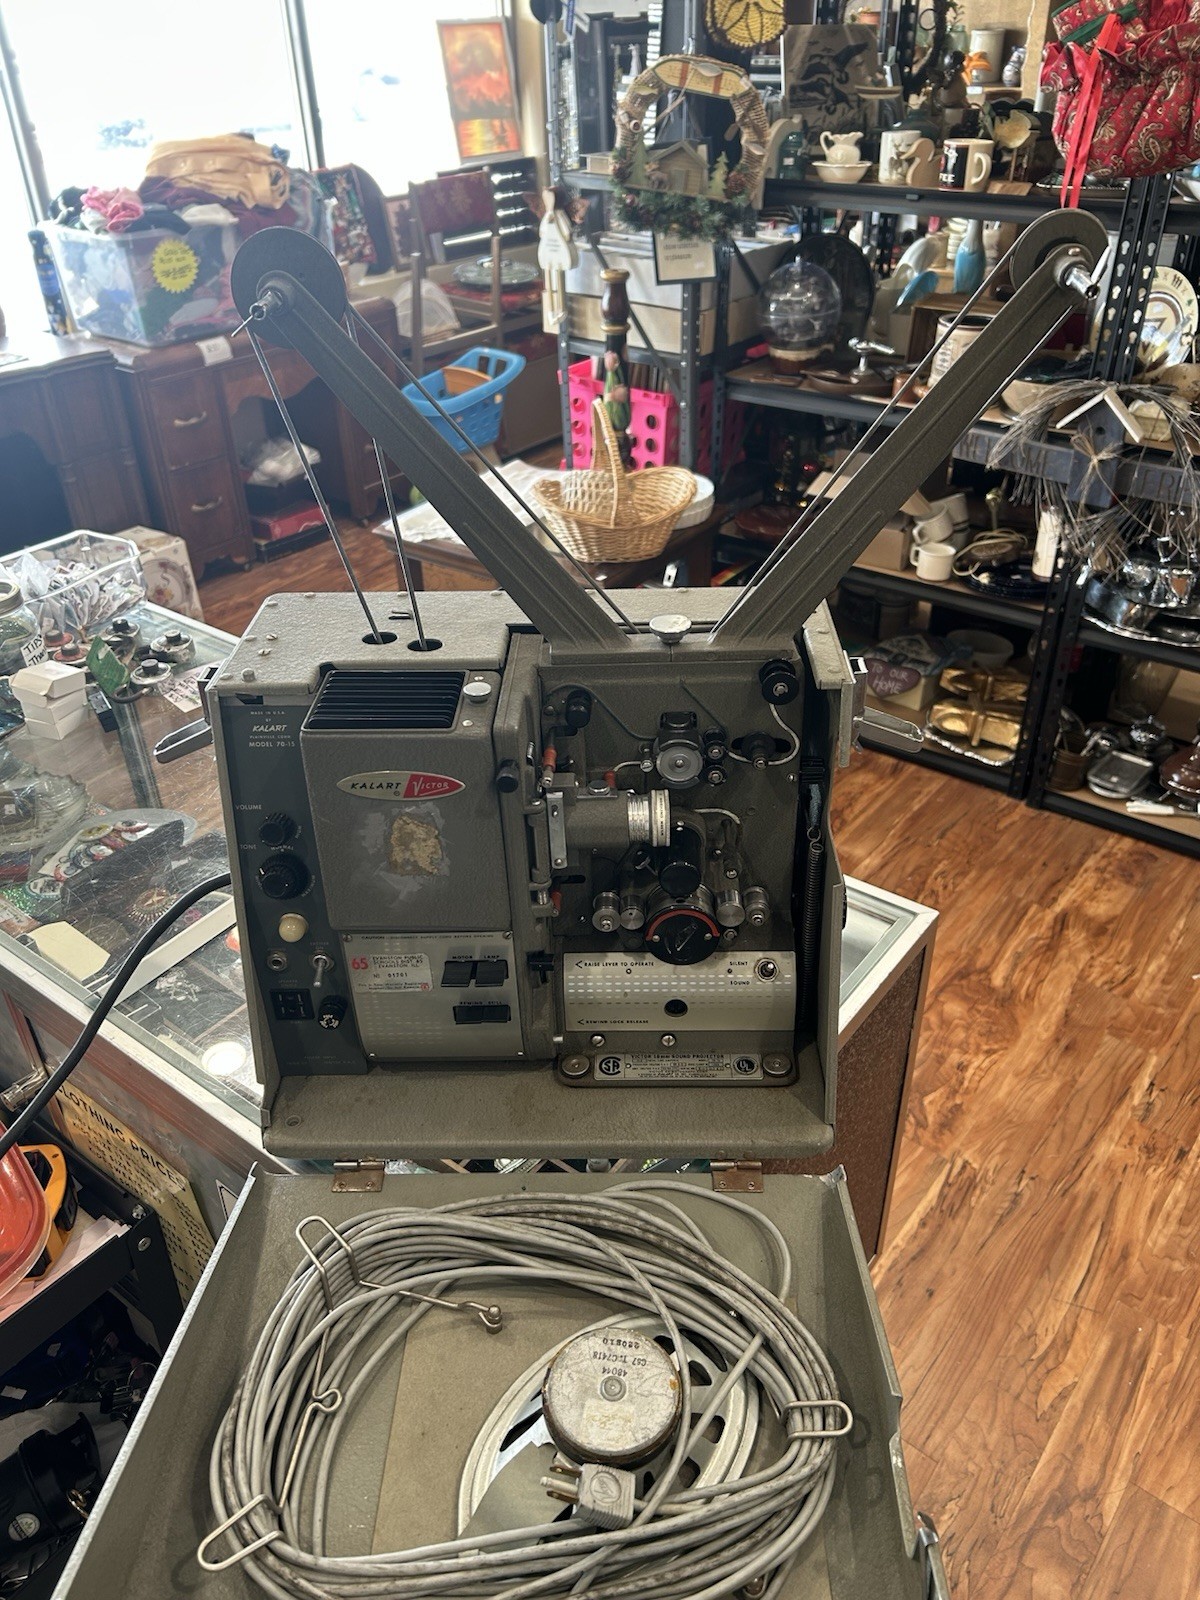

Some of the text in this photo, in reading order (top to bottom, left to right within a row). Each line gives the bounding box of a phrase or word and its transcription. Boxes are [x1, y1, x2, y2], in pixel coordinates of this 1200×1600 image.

[252, 724, 288, 732] KALART
[350, 782, 402, 791] KALART
[351, 957, 369, 971] 65
[128, 1138, 186, 1191] PRICES
